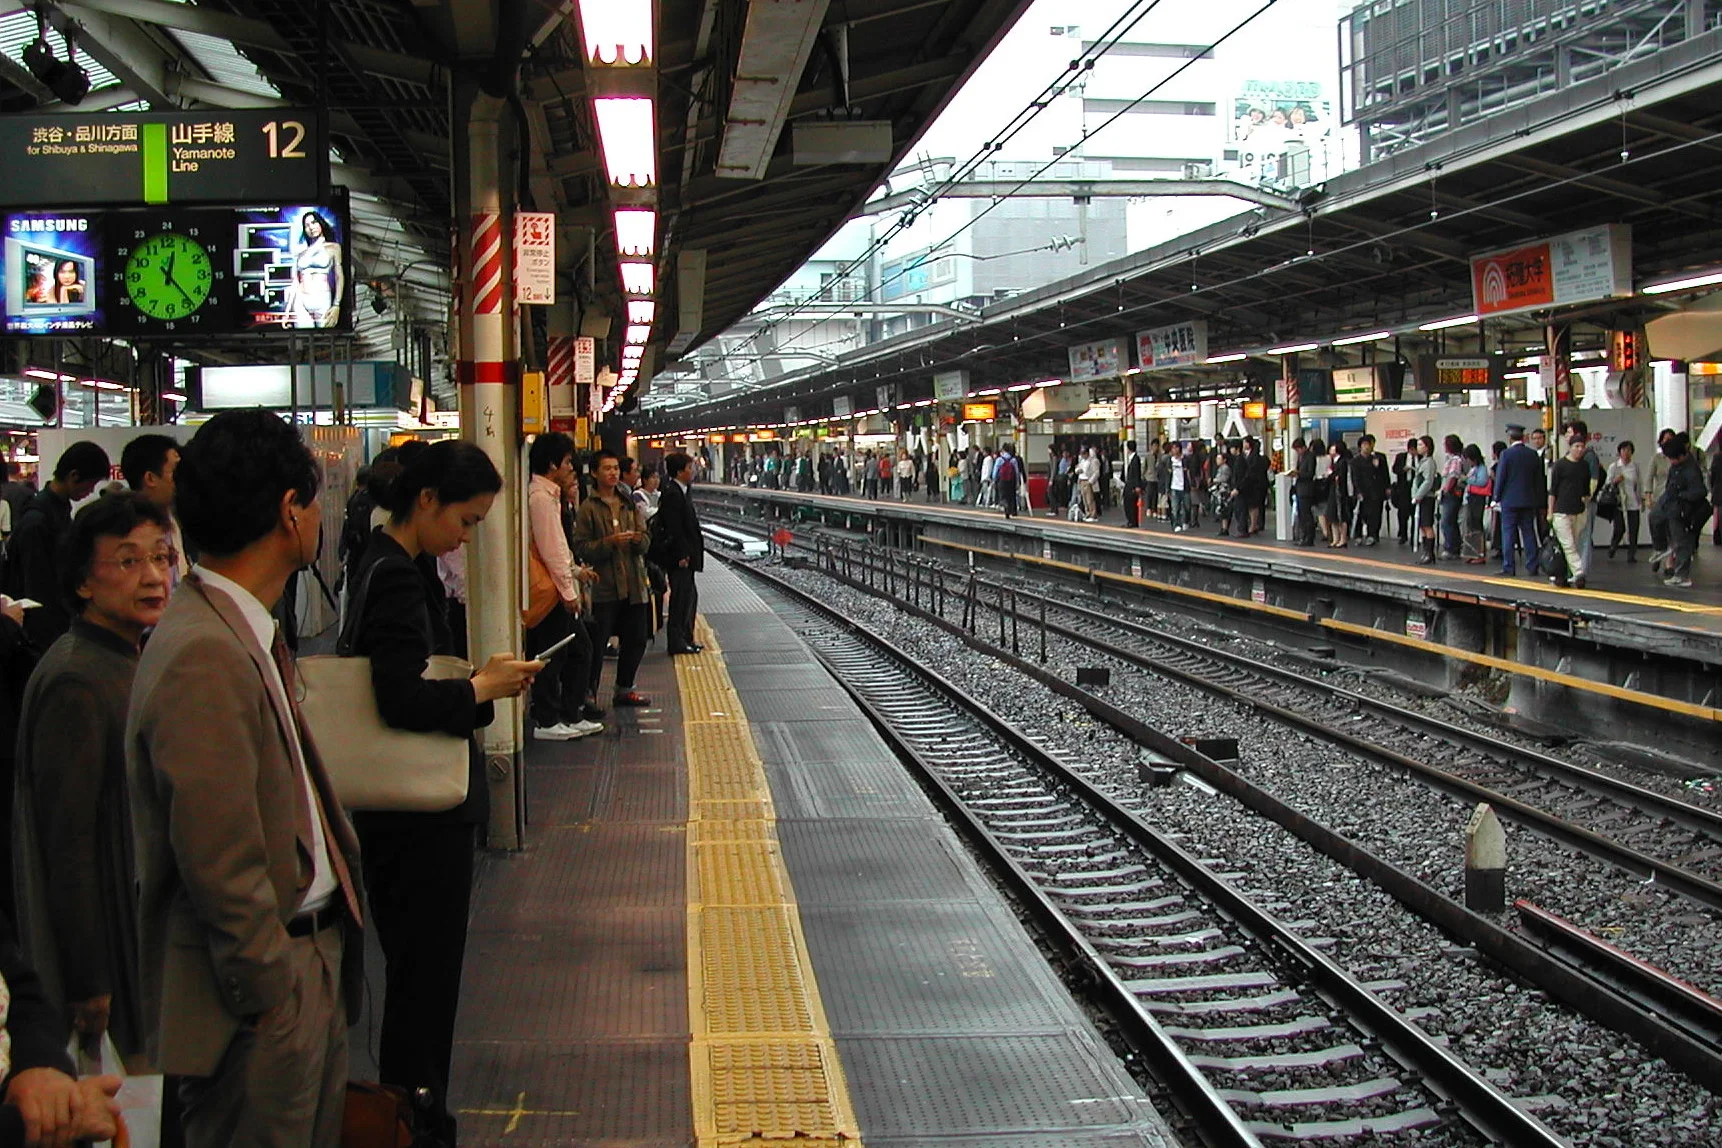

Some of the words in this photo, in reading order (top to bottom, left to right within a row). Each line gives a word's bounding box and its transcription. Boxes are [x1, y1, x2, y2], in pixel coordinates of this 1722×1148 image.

[32, 124, 138, 143] 渋谷・品川方面
[172, 122, 235, 144] 山手線
[261, 121, 306, 158] 12
[27, 146, 40, 155] for
[42, 144, 78, 156] Shibuya
[88, 143, 138, 154] Shinagawa
[172, 147, 236, 159] Yamanote
[172, 160, 199, 172] Line
[11, 219, 88, 232] SAMSUNG
[162, 221, 173, 230] 24
[134, 230, 146, 239] 23
[189, 228, 199, 236] 13
[160, 238, 176, 249] 12
[207, 245, 217, 253] 14
[117, 248, 129, 256] 22
[146, 244, 159, 256] 11
[135, 257, 150, 268] 10
[191, 253, 202, 265] 2
[113, 273, 124, 281] 21
[130, 272, 142, 283] 9
[196, 269, 207, 281] 3
[215, 271, 225, 279] 15
[136, 287, 147, 299] 8
[192, 285, 202, 296] 4
[522, 287, 532, 301] 12
[119, 298, 131, 306] 20
[148, 299, 158, 311] 7
[208, 297, 218, 306] 16
[165, 303, 176, 315] 6
[137, 315, 148, 324] 19
[191, 315, 201, 323] 17
[165, 322, 176, 331] 18
